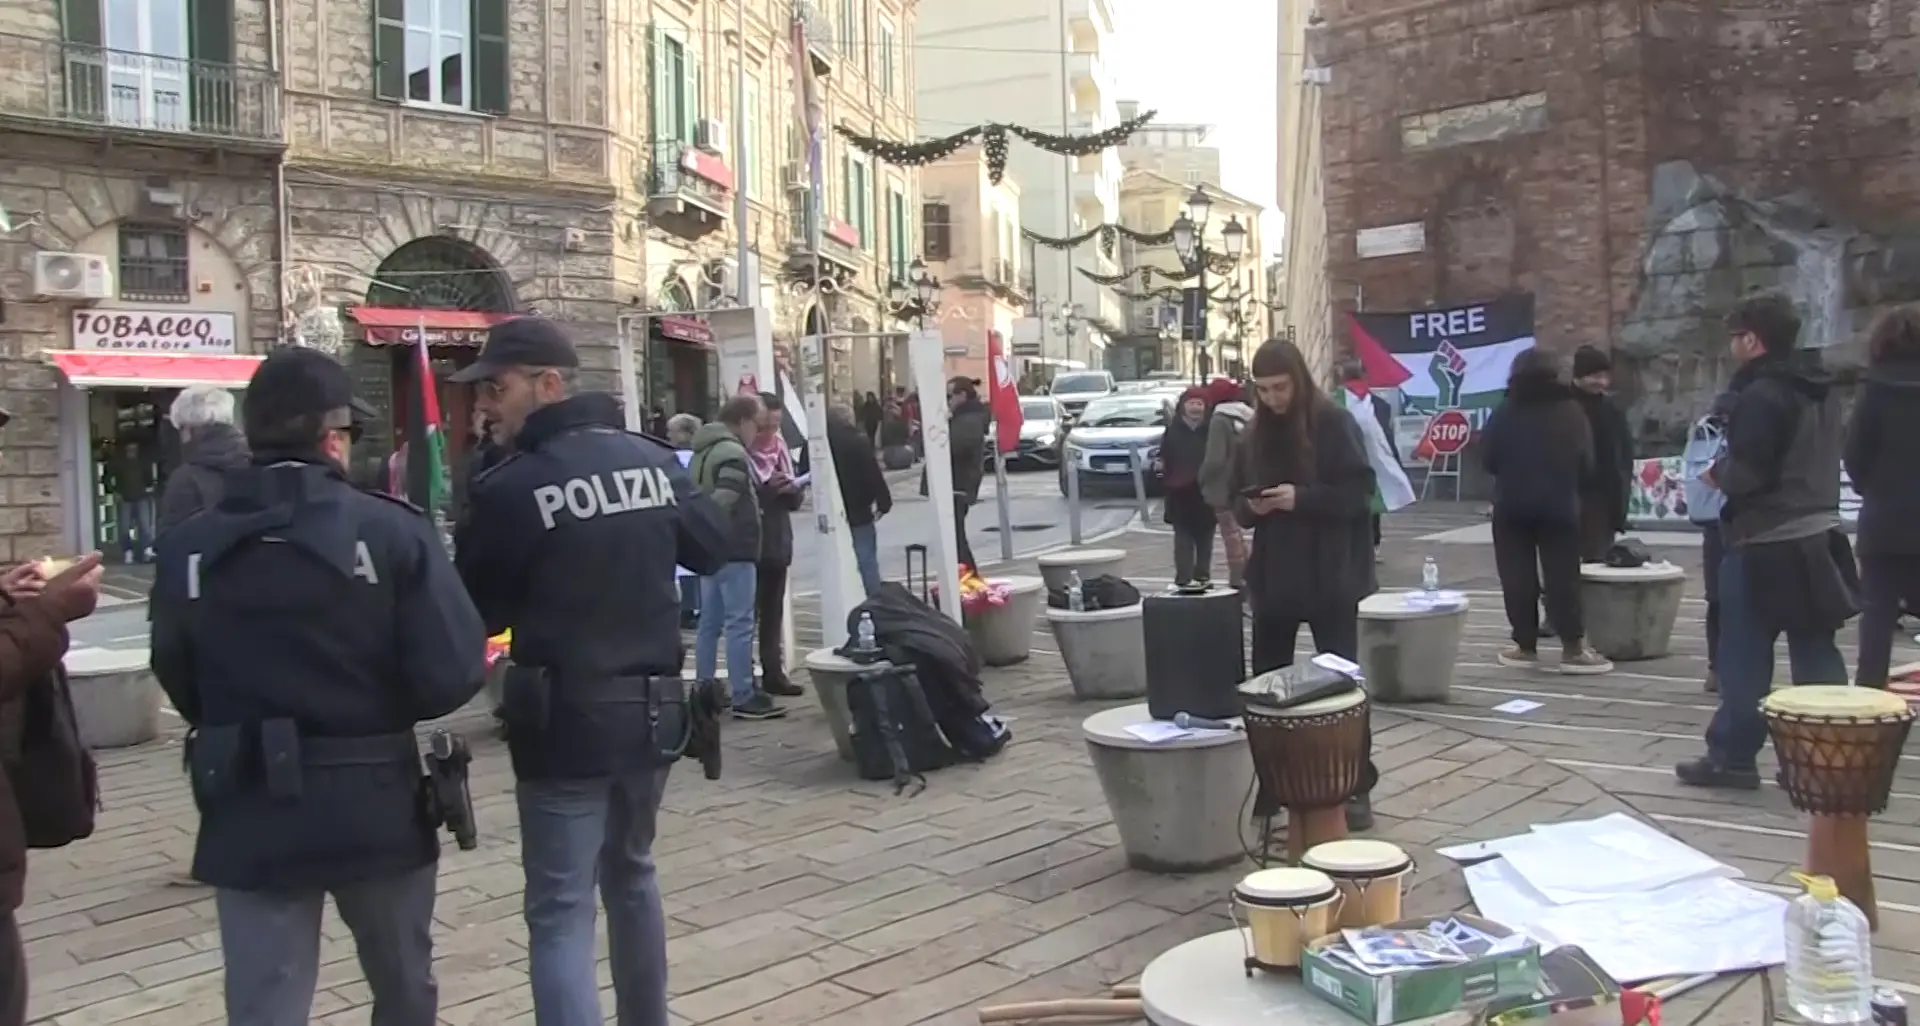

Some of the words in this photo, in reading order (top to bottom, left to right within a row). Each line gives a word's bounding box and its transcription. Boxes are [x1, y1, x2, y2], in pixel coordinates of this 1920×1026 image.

[77, 313, 211, 339] TOBACCO
[1410, 306, 1486, 338] FREE
[1431, 424, 1468, 441] STOP
[533, 467, 678, 531] POLIZIA
